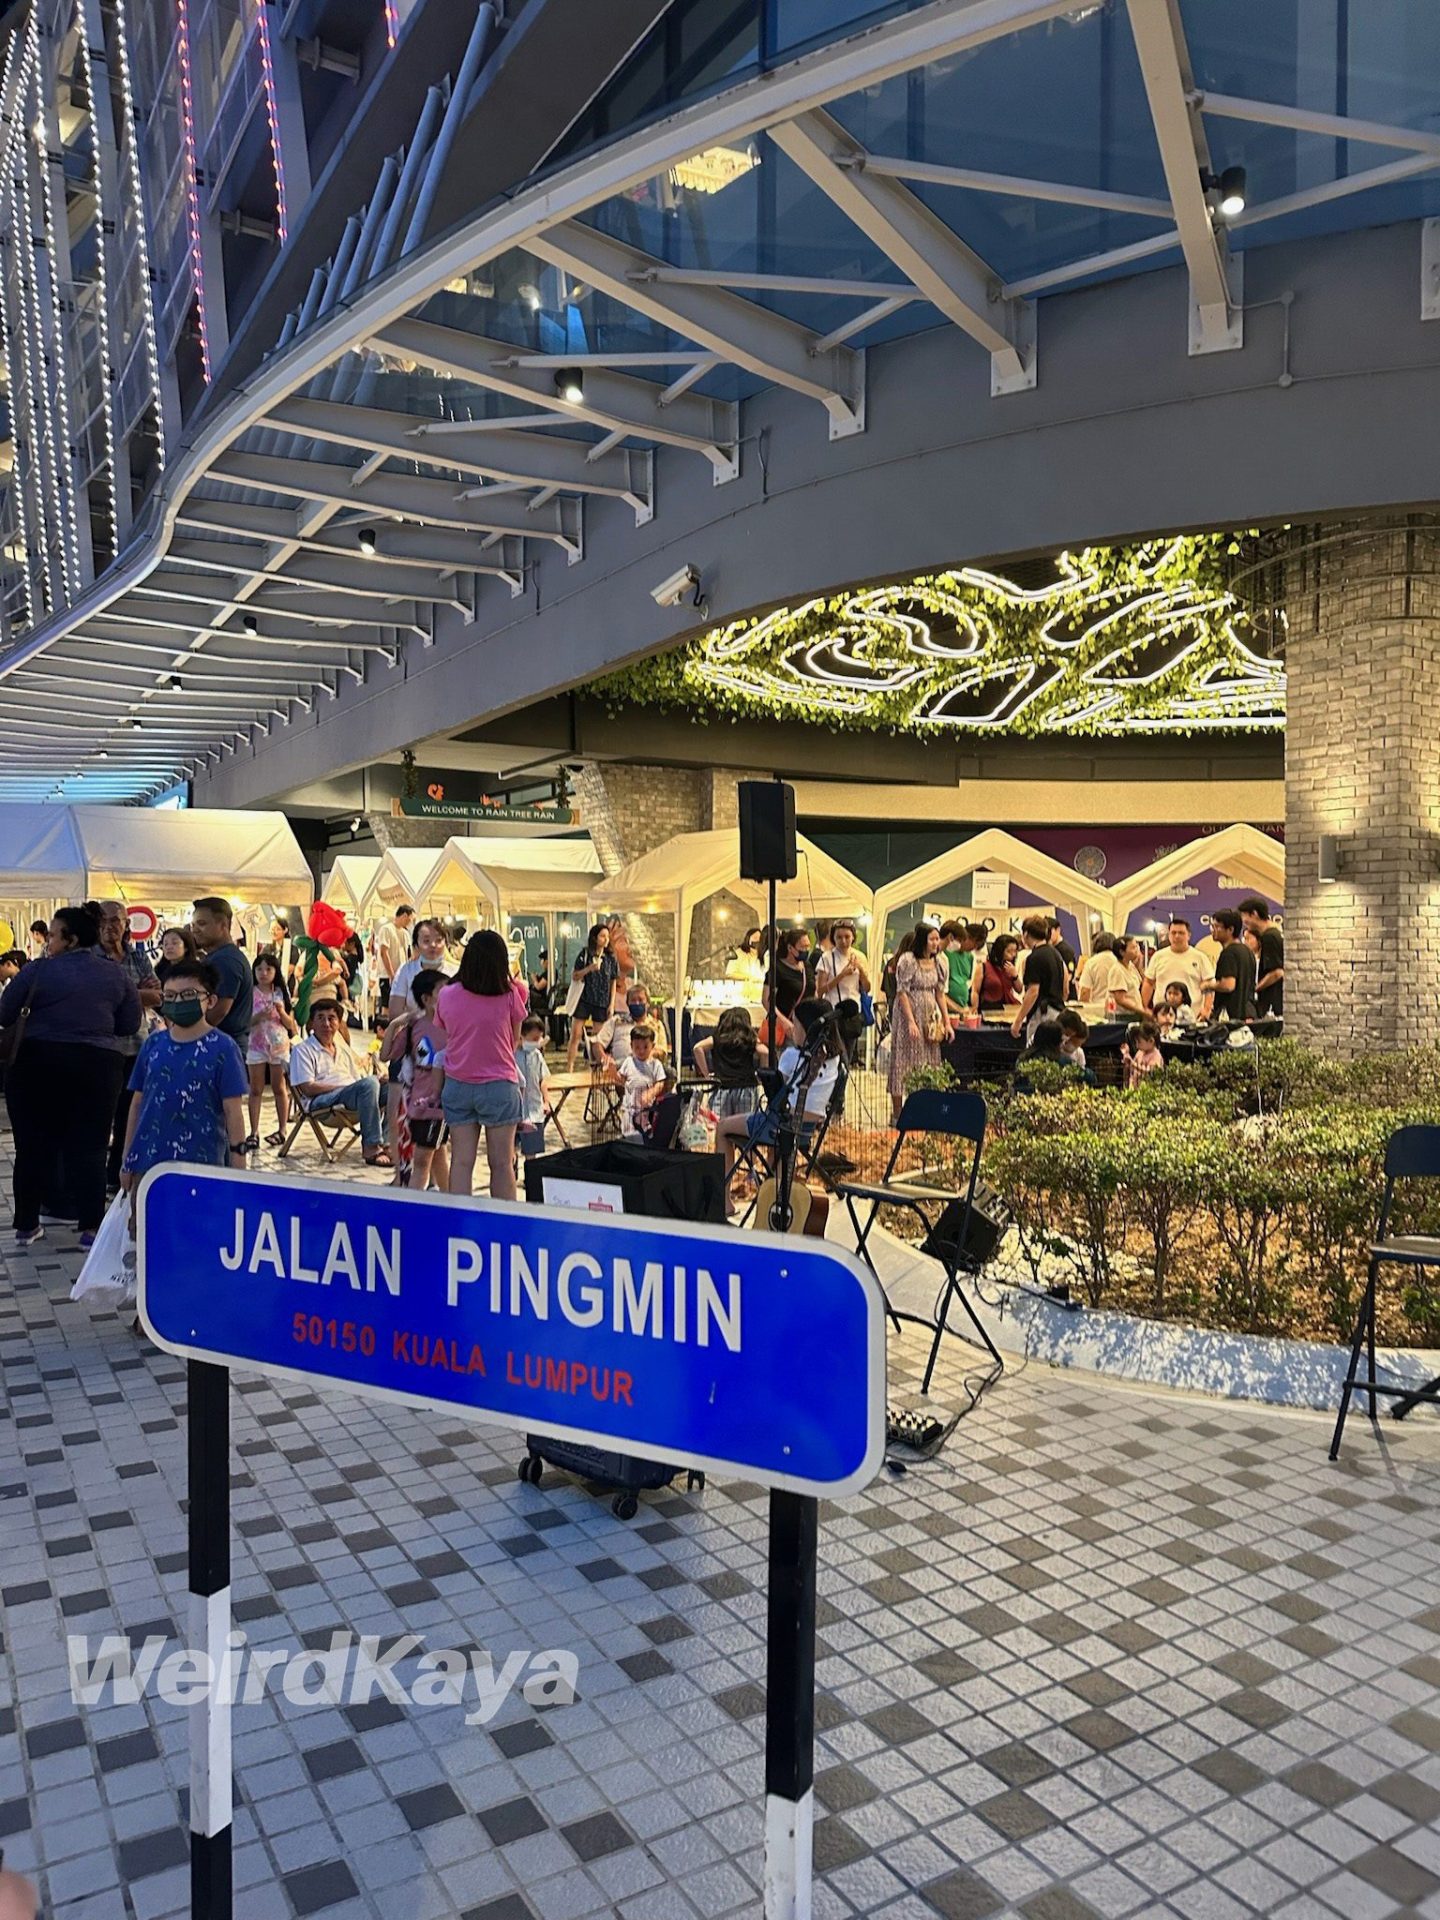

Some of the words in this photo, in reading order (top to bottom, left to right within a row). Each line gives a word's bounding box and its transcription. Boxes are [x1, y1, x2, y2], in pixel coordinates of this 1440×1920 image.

[421, 804, 469, 816] WELCOME
[471, 807, 484, 816] TO
[486, 808, 508, 818] RAIN
[511, 809, 532, 819] TREE
[534, 811, 555, 821] RAIN
[523, 921, 540, 940] rain
[219, 1208, 402, 1297] JALAN
[446, 1236, 742, 1353] PINGMIN
[292, 1312, 376, 1356] 50150
[393, 1331, 487, 1378] KUALA
[506, 1352, 634, 1406] LUMPUR
